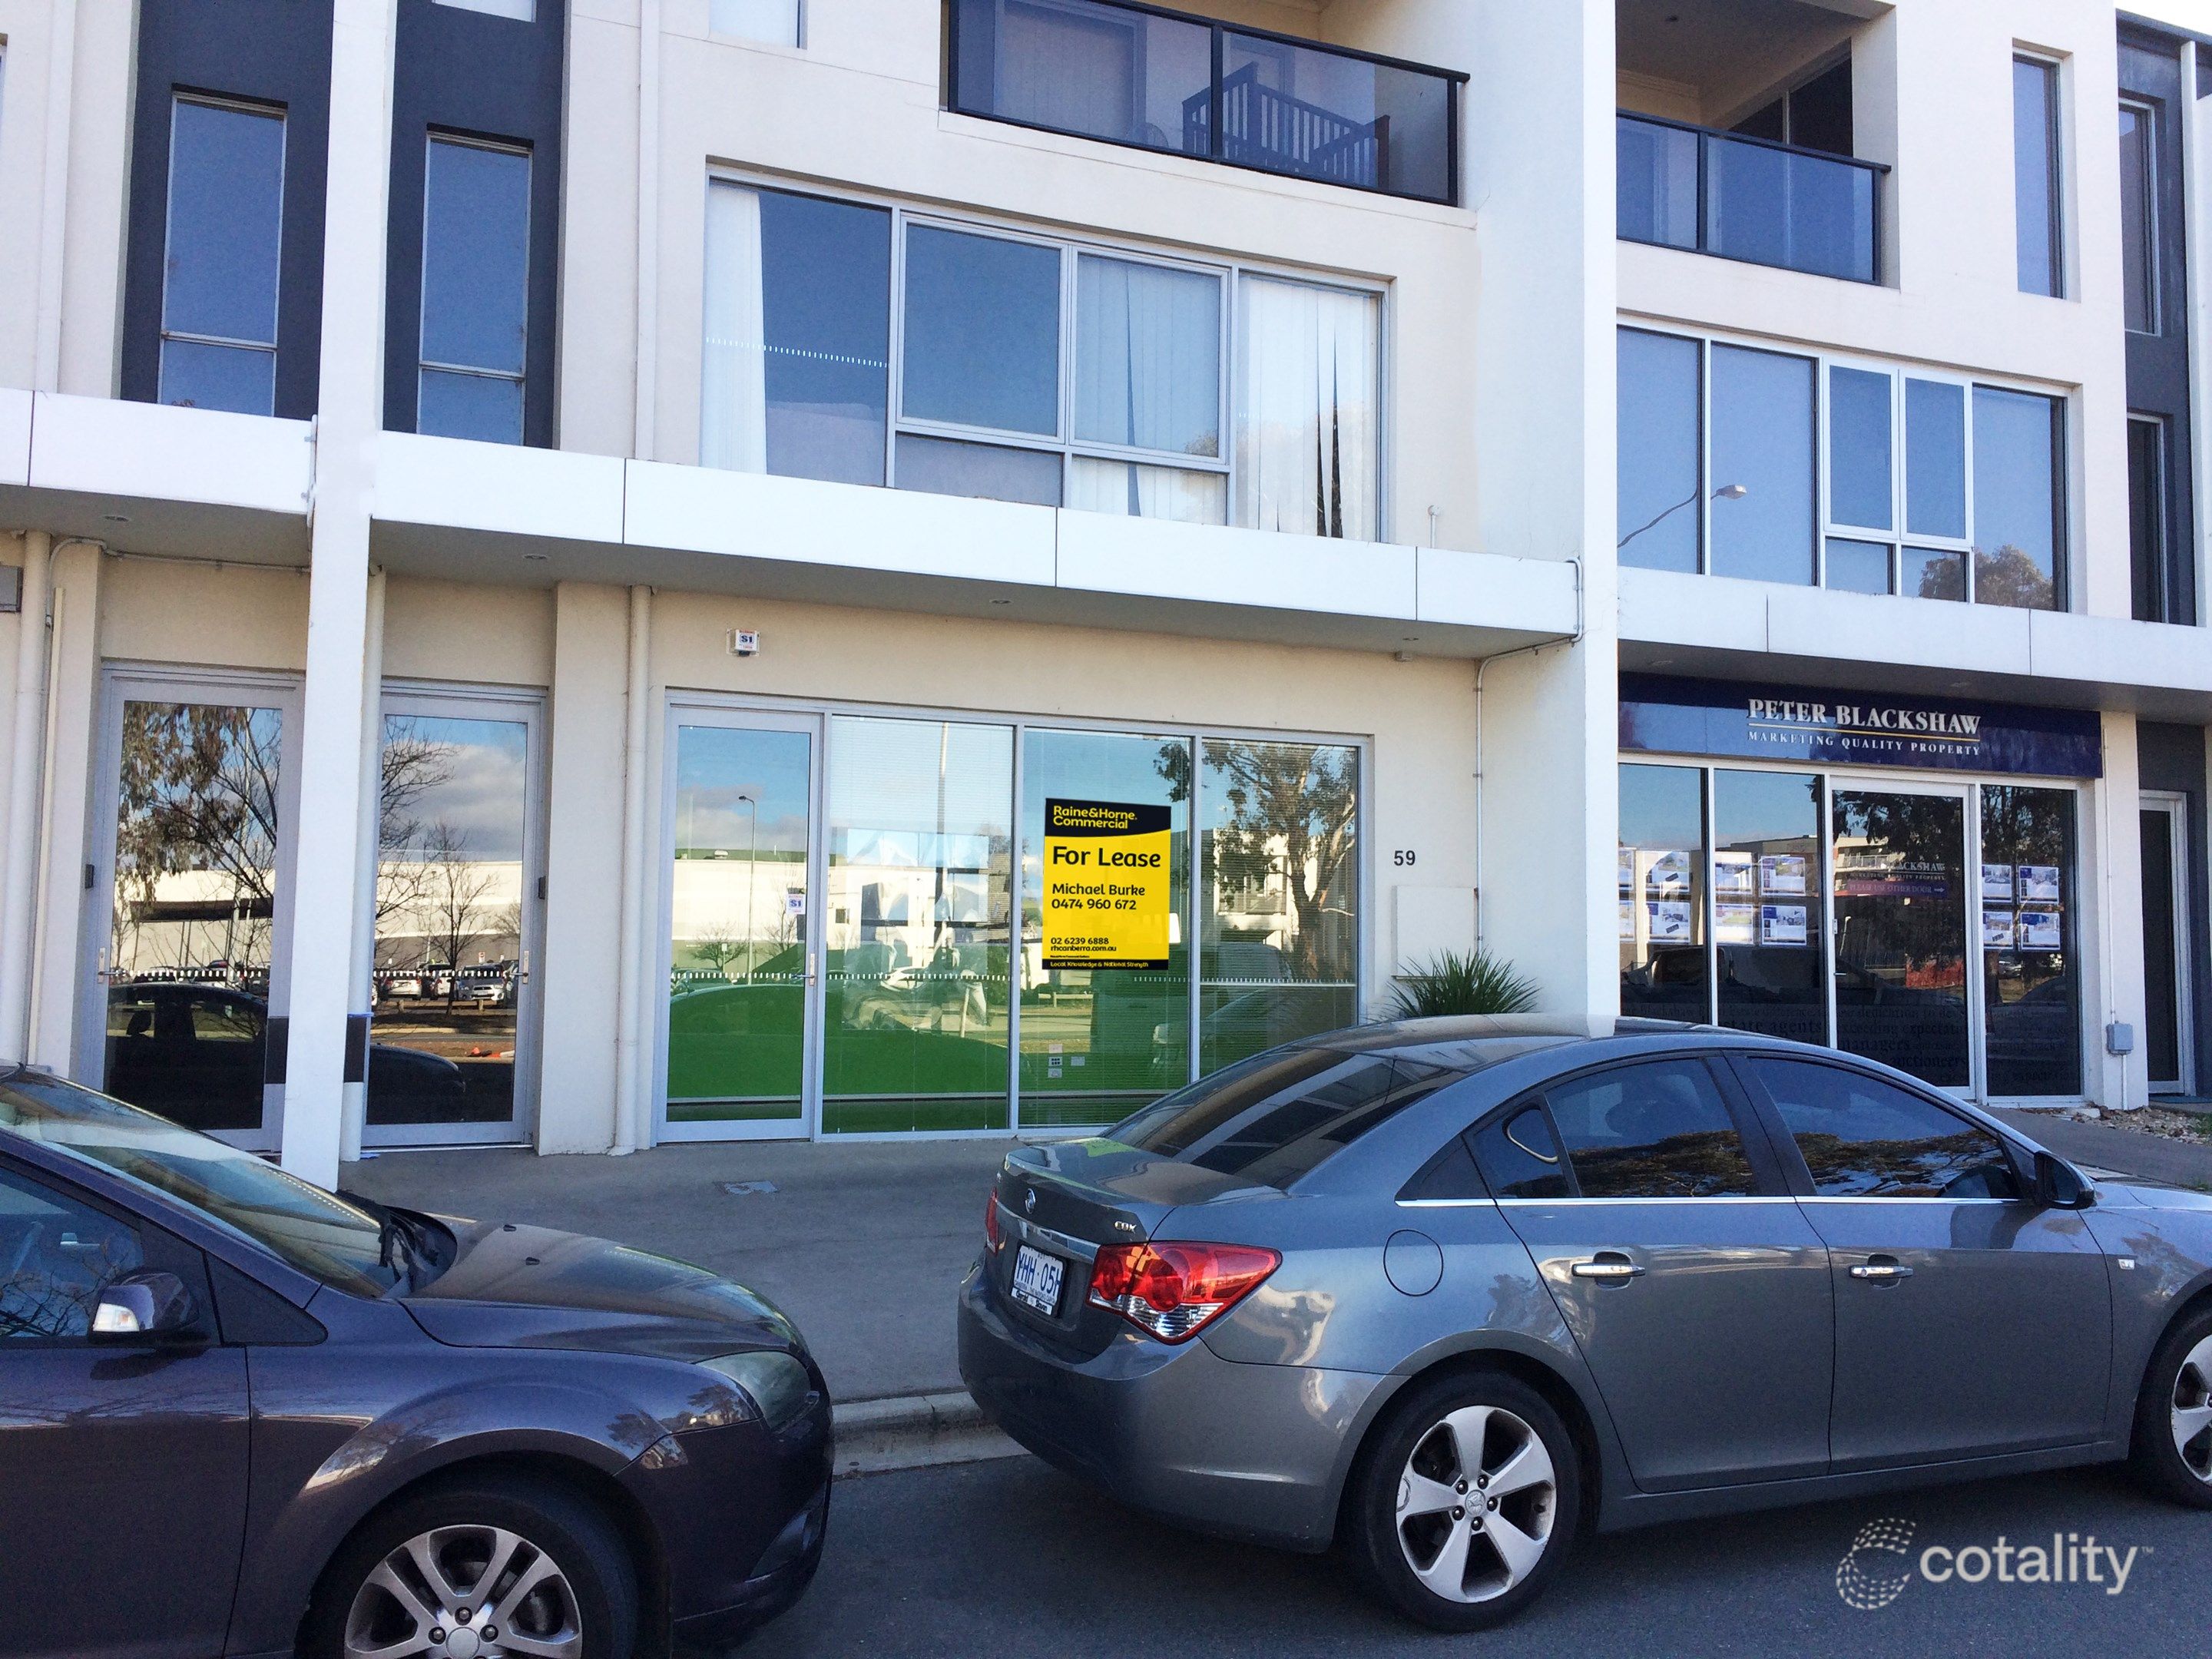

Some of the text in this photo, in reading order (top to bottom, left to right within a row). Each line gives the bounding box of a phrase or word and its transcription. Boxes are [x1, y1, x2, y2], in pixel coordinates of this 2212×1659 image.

[1747, 698, 1982, 735] PETER BLACKSHAW
[1747, 731, 1981, 756] MARKETING QUALITY PROPERTY
[1053, 816, 1128, 830] Commercial
[1053, 846, 1161, 868] For Lease
[1393, 849, 1416, 866] 59
[1052, 883, 1145, 896] Michael Burke
[1051, 899, 1137, 910] 0474 960 672
[1114, 1220, 1137, 1234] CDX
